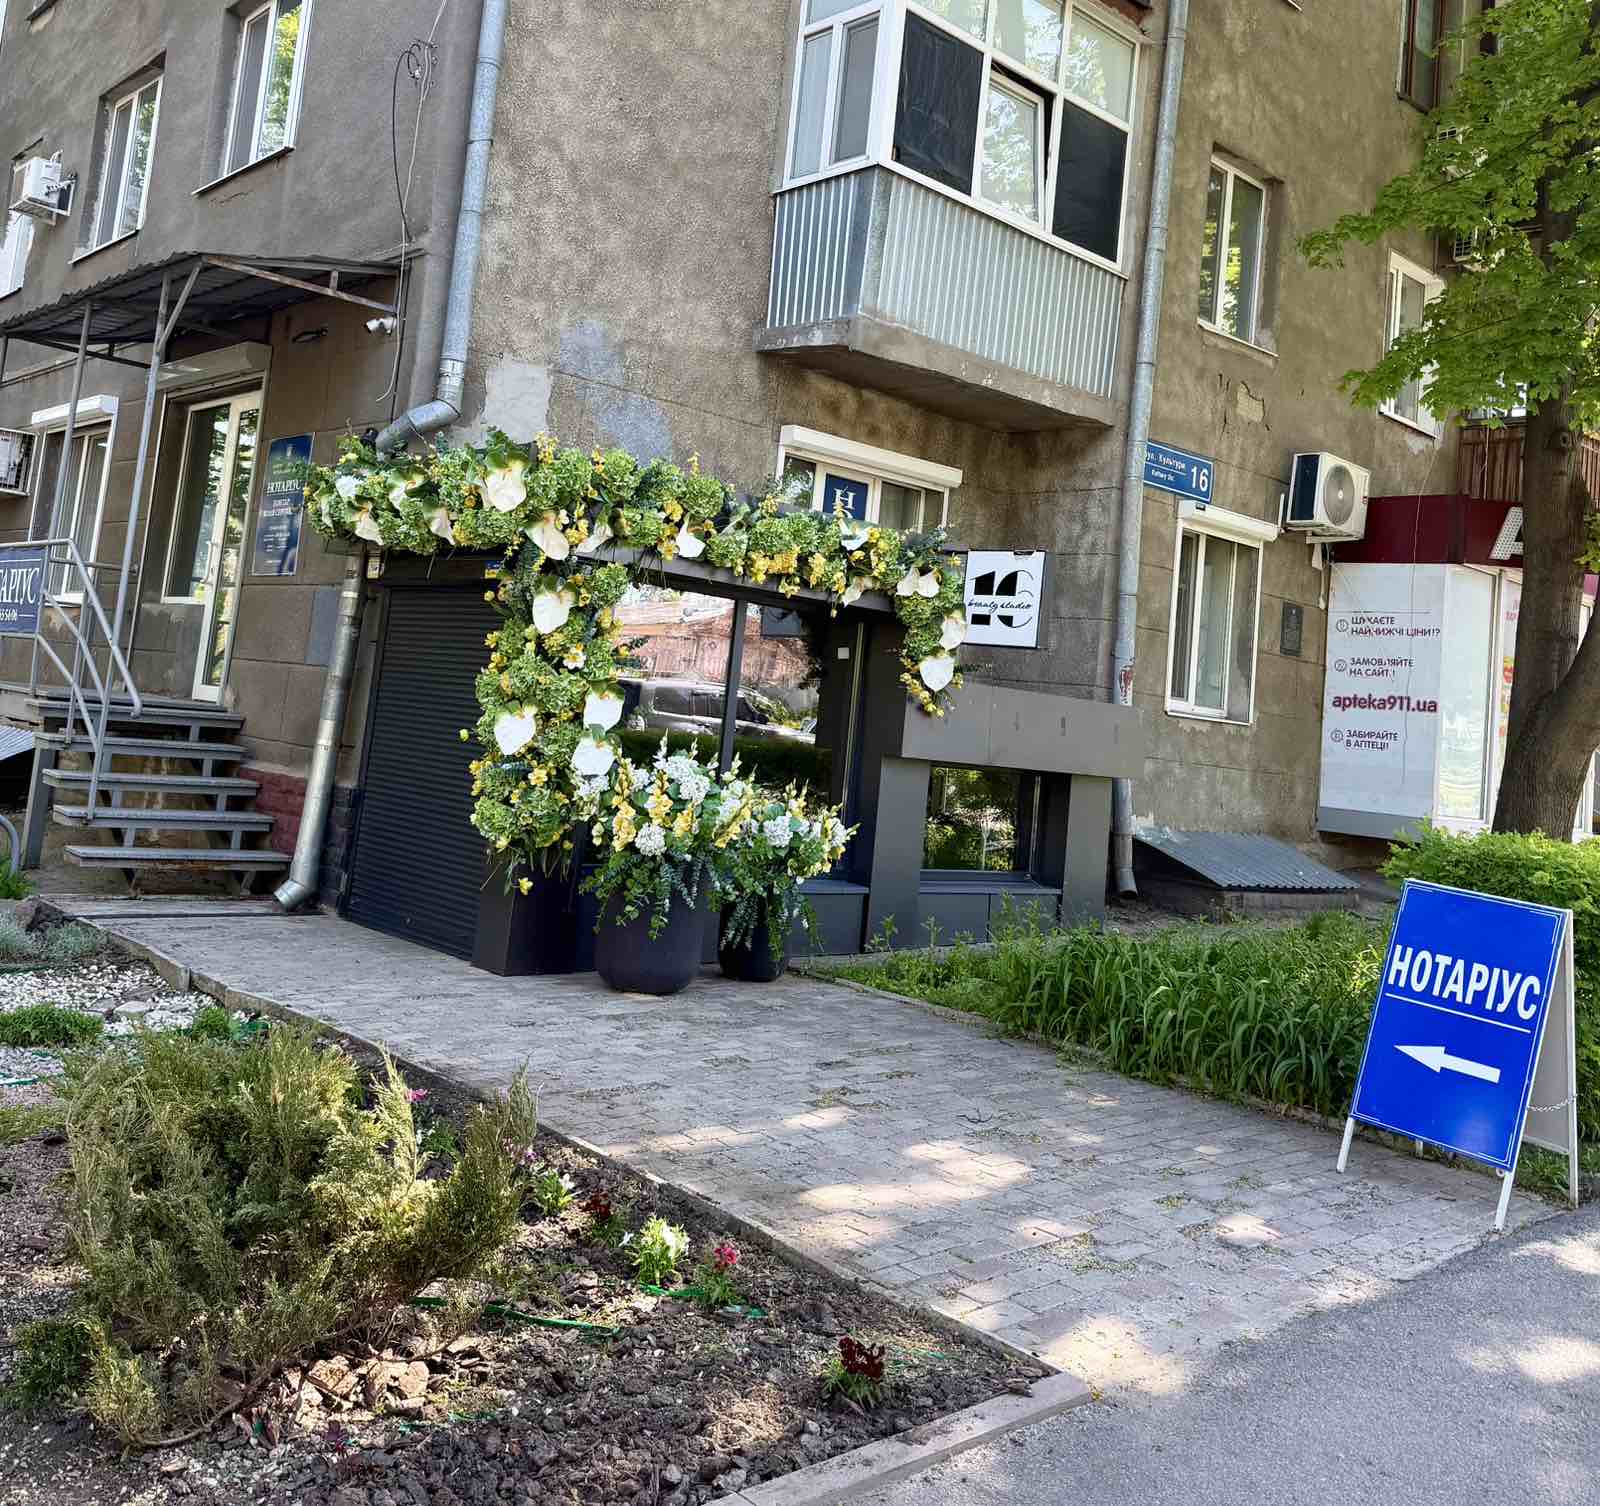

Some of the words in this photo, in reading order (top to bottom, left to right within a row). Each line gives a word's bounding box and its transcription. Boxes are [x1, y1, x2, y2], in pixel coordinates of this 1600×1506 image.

[1191, 465, 1209, 492] 16
[1350, 656, 1415, 668] ЗАМОВЛЯЙТЕ
[1349, 668, 1362, 677] НА
[1365, 667, 1396, 678] САЙТ!
[1332, 693, 1438, 713] apteka911.ua
[1346, 729, 1399, 741] ЗАБИРАЙТЕ
[1346, 739, 1352, 748] В
[1388, 944, 1541, 1021] НОТАРІУС
